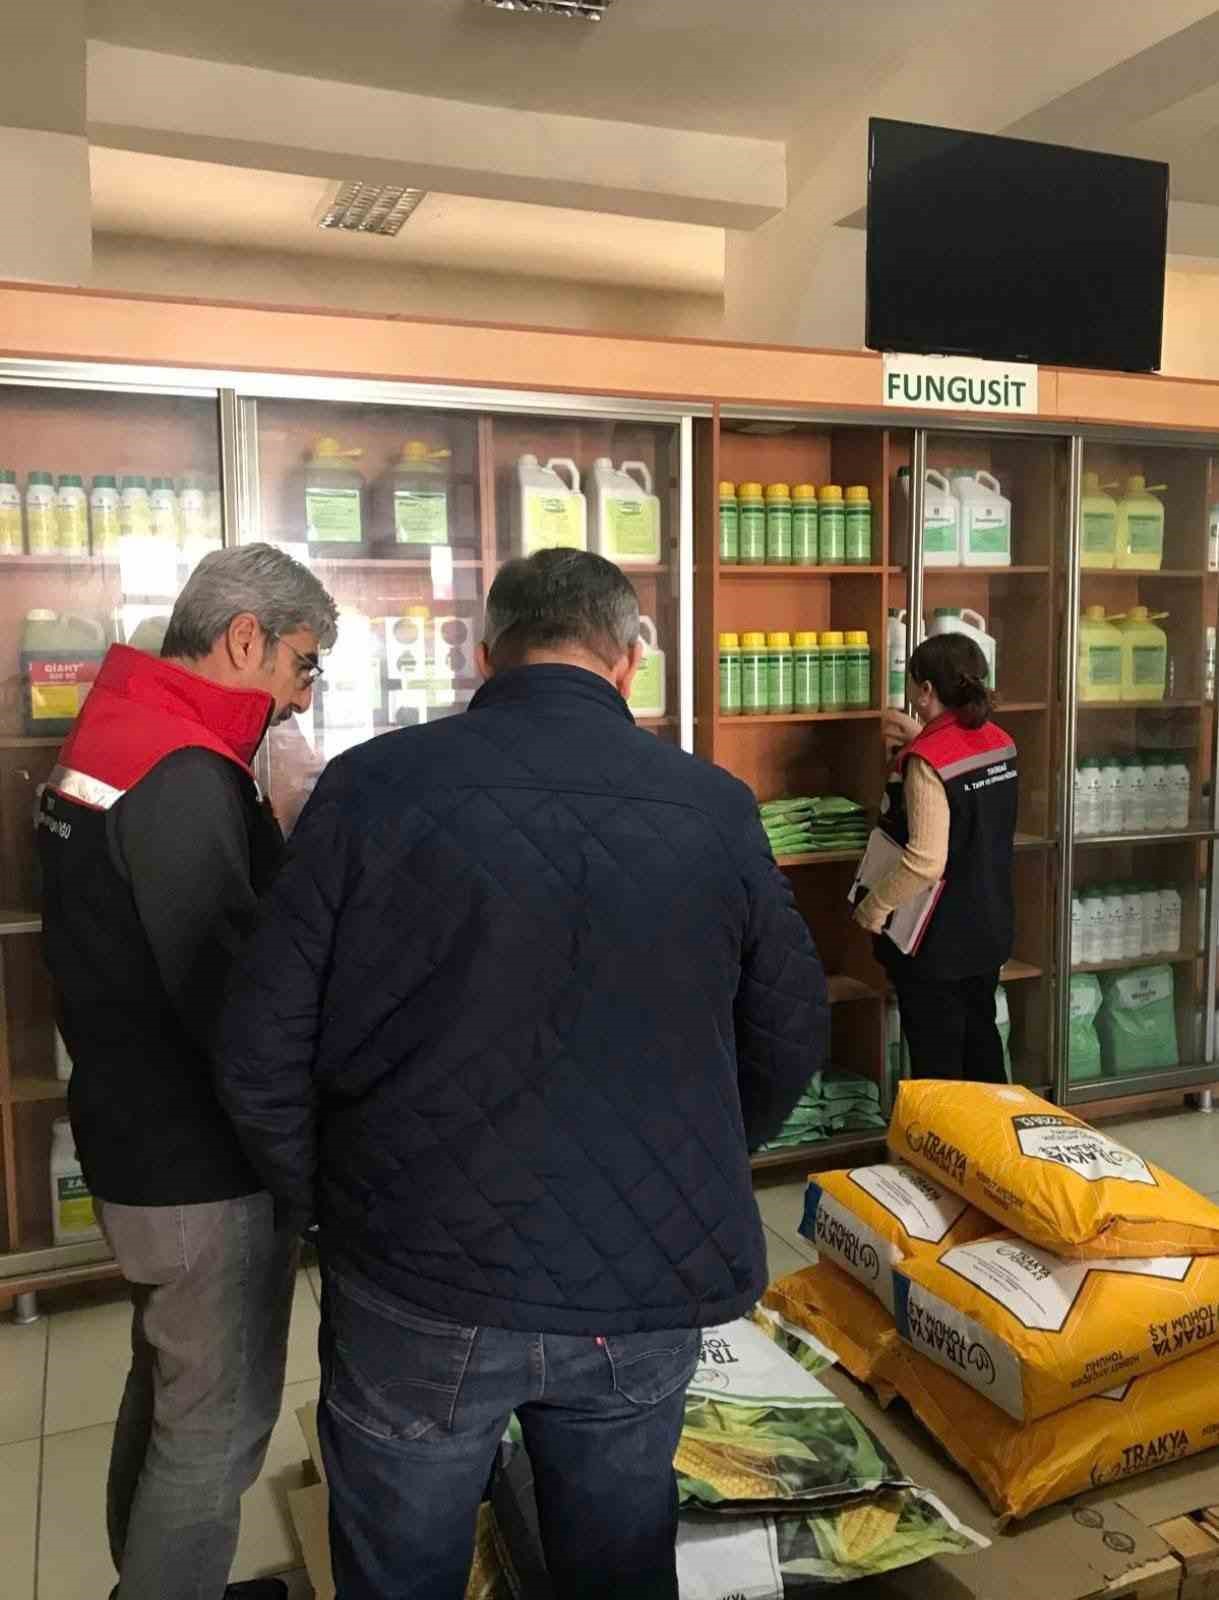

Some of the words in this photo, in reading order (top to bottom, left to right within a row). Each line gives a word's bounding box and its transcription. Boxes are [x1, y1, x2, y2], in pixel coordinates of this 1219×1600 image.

[887, 373, 1027, 408] FUNGUSİT
[925, 1130, 968, 1168] TRAKYA
[816, 1222, 859, 1267] TRAKYA
[925, 1312, 967, 1350] TOHUM
[1170, 1304, 1217, 1330] TOHUM
[910, 1319, 967, 1371] TRAKYA
[1151, 1318, 1217, 1358] TRAKYA
[1121, 1429, 1190, 1467] TRAKYA
